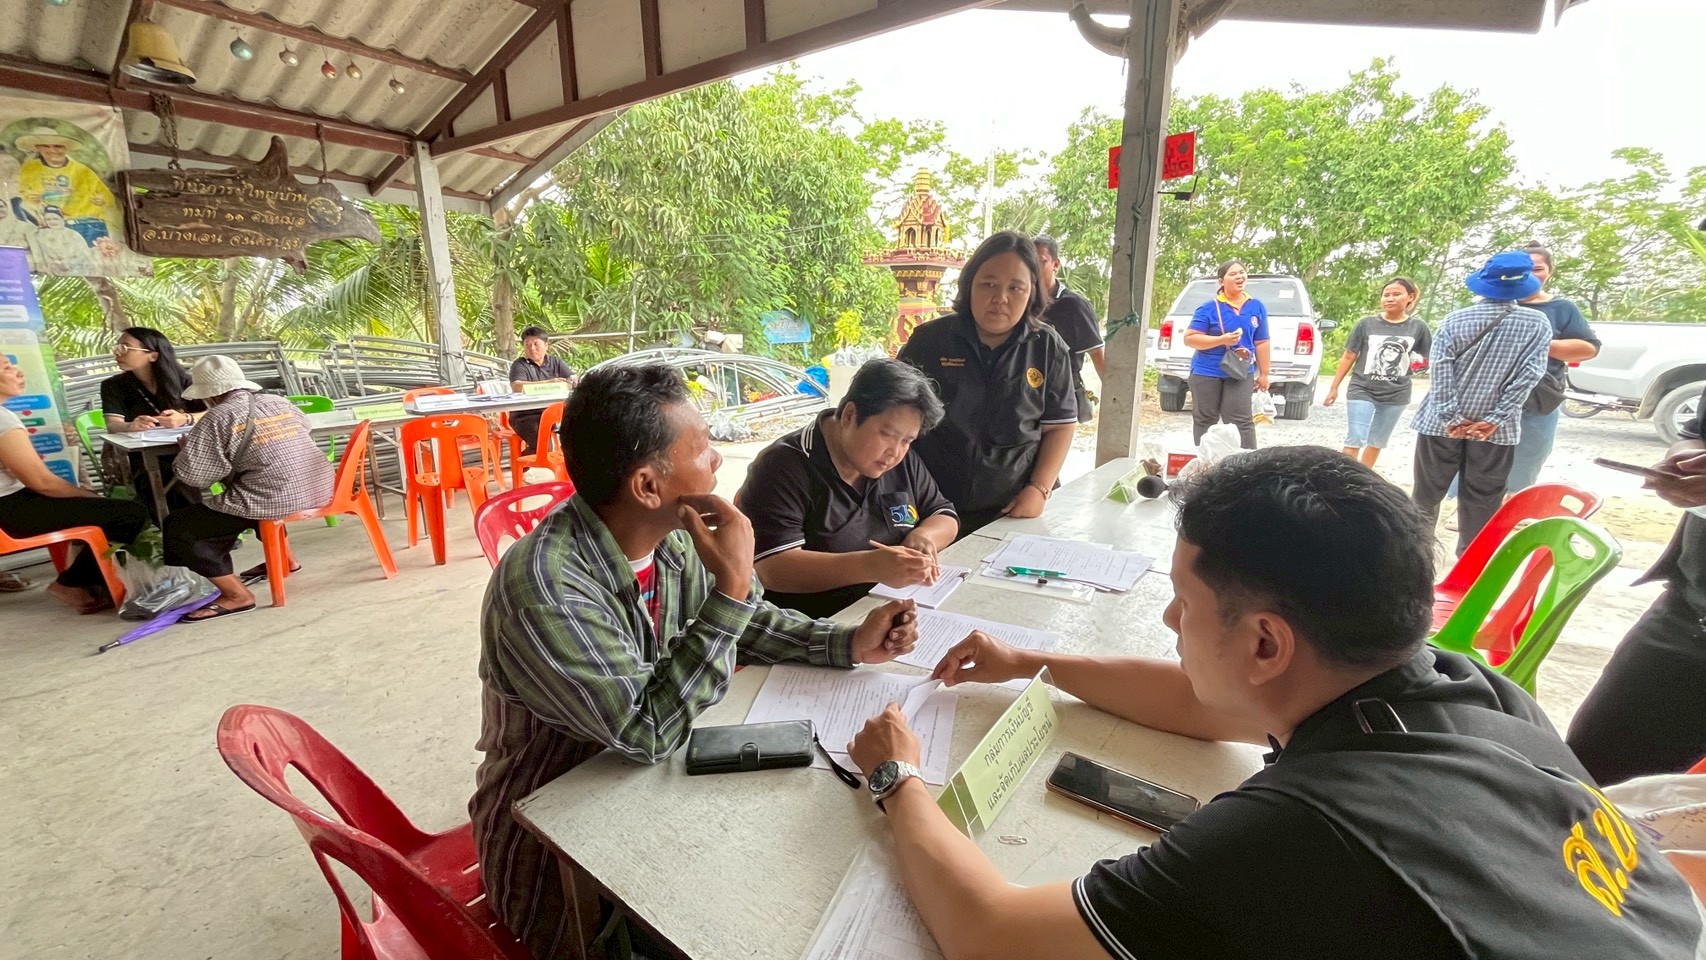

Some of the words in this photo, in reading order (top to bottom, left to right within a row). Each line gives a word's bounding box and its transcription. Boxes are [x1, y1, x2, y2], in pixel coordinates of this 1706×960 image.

[142, 229, 223, 244] อ.บางเลน
[984, 697, 1034, 767] กลุ่มการเงินบัญชี
[987, 712, 1053, 811] และจัดเก็บผลประโยชน์
